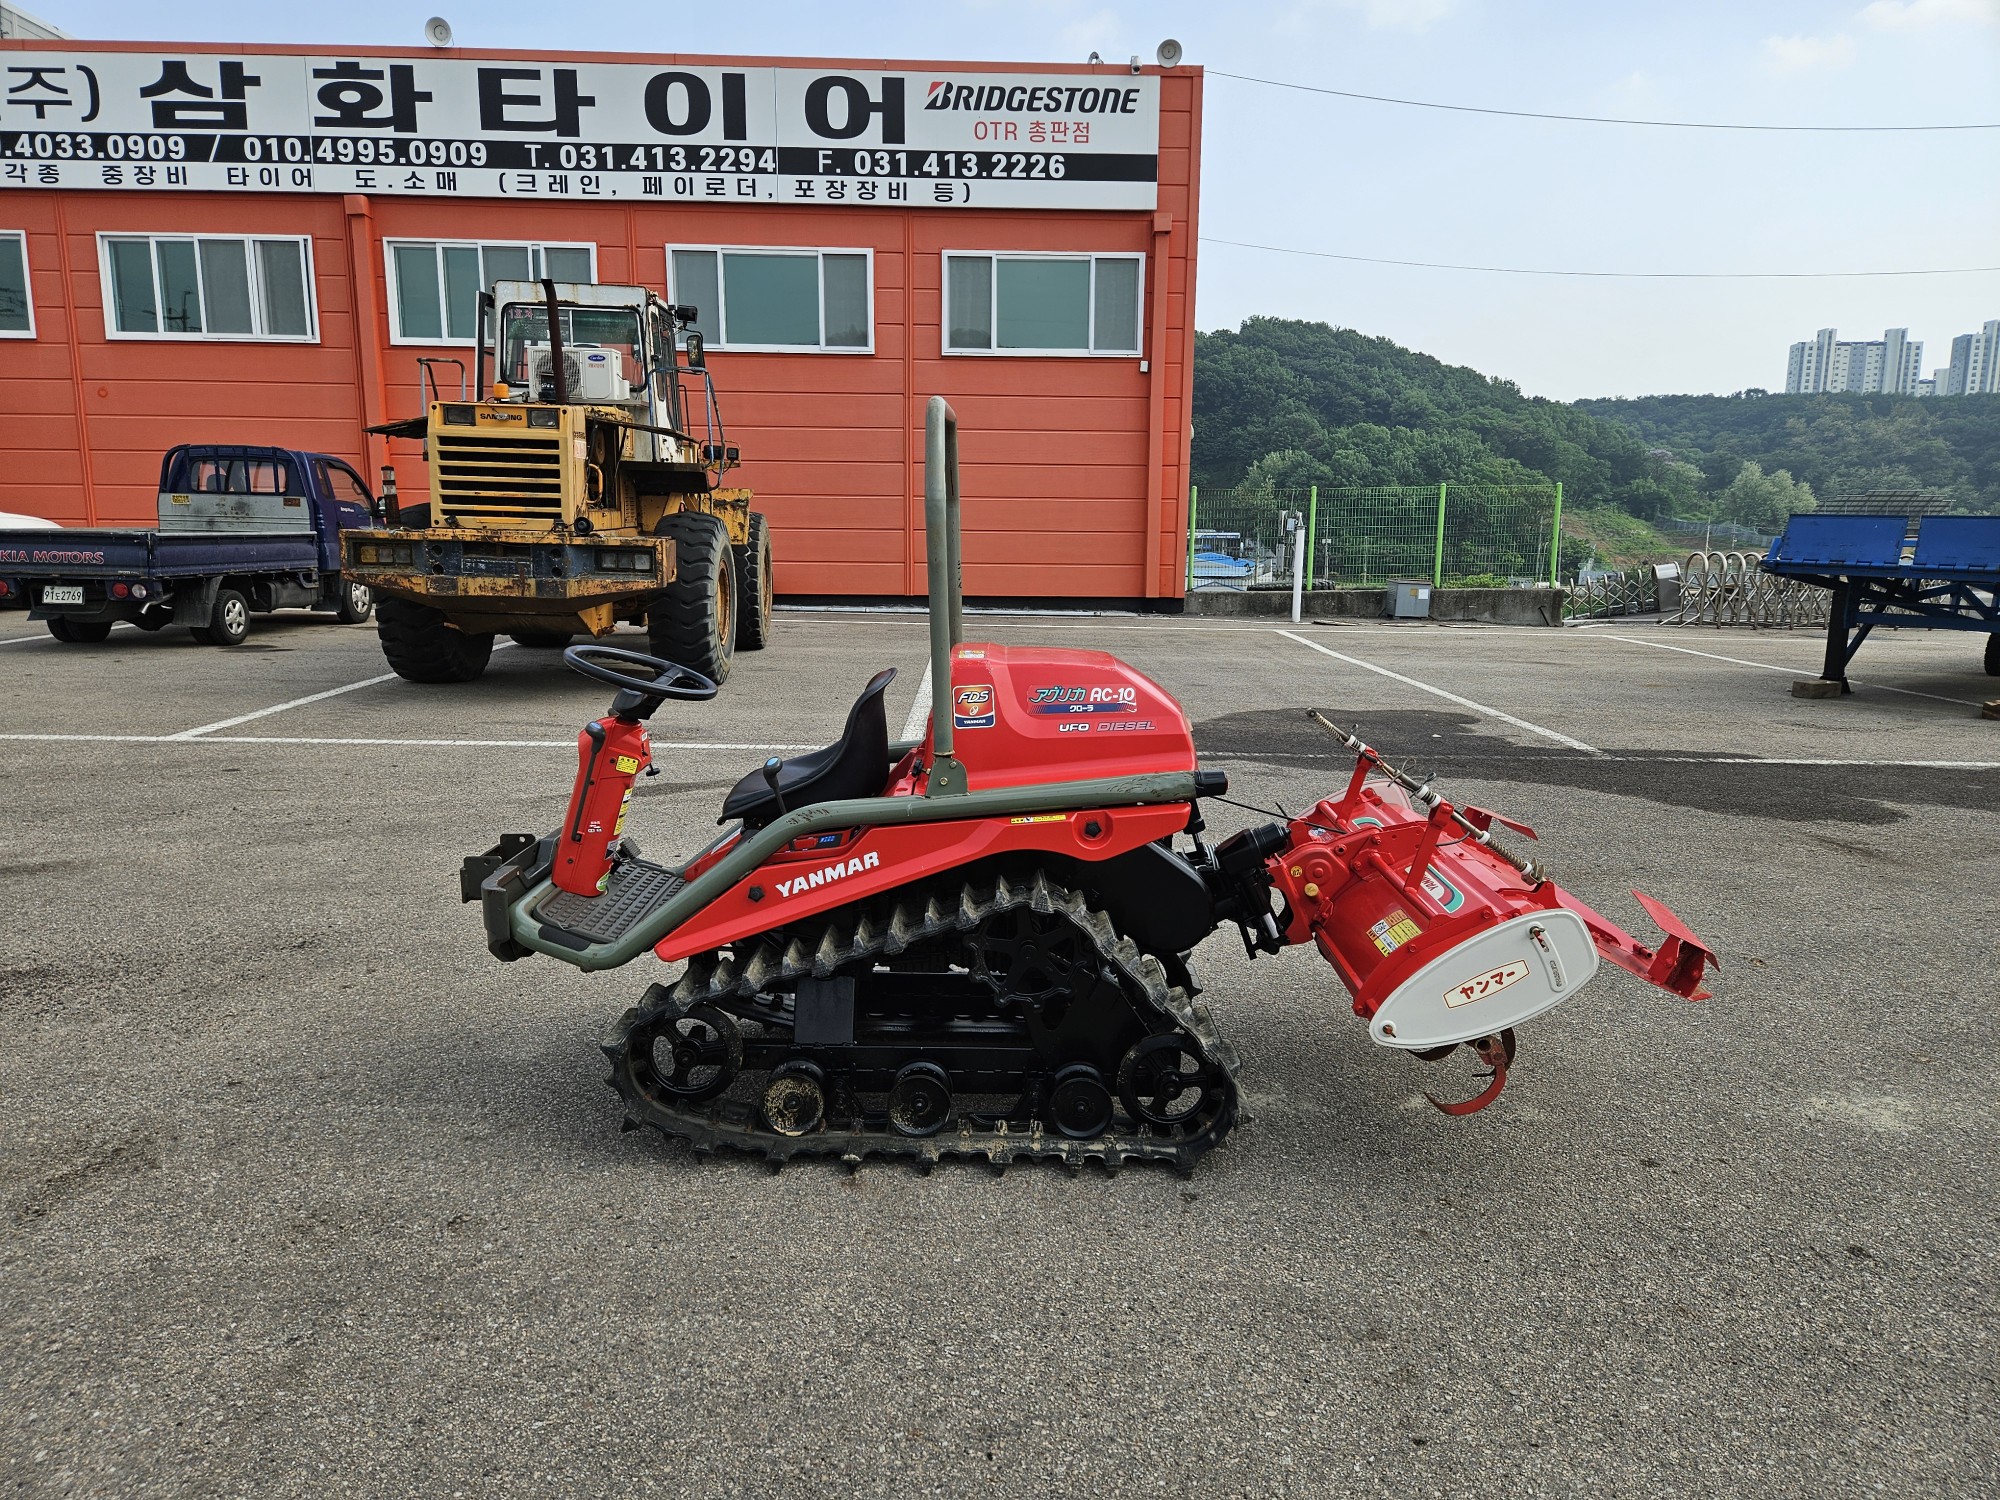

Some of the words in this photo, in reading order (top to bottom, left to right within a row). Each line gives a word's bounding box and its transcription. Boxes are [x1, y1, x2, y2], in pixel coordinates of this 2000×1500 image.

[0, 64, 101, 123] 주)
[924, 81, 1140, 114] BRIDGESTONE
[974, 121, 1018, 141] OTR
[1028, 120, 1090, 144] 총판점
[0, 133, 186, 160] .4033.0909
[243, 137, 488, 167] 010.4995.0909
[559, 145, 776, 173] 031.413.2294
[854, 151, 1066, 179] 031.413.2226
[5, 163, 60, 184] 각종
[101, 165, 188, 186] 중장비
[227, 167, 313, 188] 타이어
[498, 173, 618, 197] (크레인,
[642, 176, 774, 199] 페이로더,
[794, 179, 908, 201] 포장장비
[933, 182, 972, 203] 등)
[0, 549, 30, 563] KIA
[33, 550, 105, 565] MOTORS
[957, 690, 990, 704] FDS
[1030, 686, 1086, 703] アグリカ
[1089, 687, 1135, 702] AC-10
[1069, 704, 1094, 713] クローラ
[1059, 723, 1090, 732] UFO
[1096, 721, 1156, 732] DIESEL
[775, 850, 880, 898] YANMAR
[1459, 971, 1516, 1000] ヤンマー
